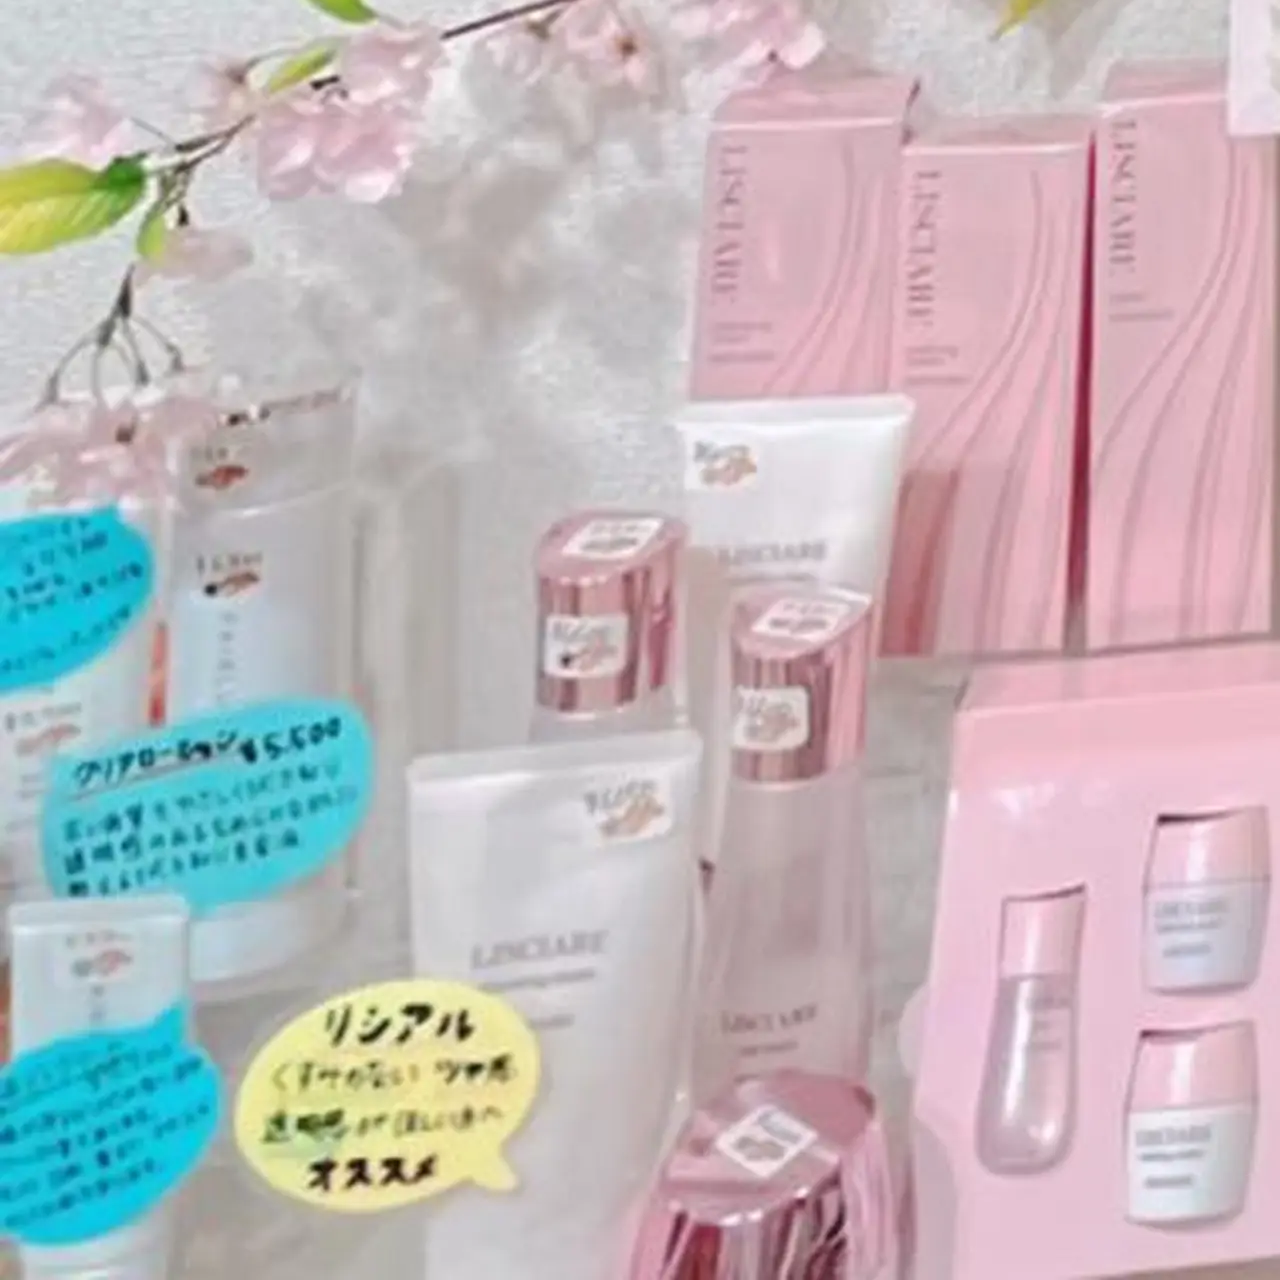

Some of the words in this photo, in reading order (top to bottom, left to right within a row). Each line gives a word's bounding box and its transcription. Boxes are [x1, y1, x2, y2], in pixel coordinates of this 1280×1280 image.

[324, 1004, 474, 1048] リシアル
[306, 1152, 438, 1192] オススメ
